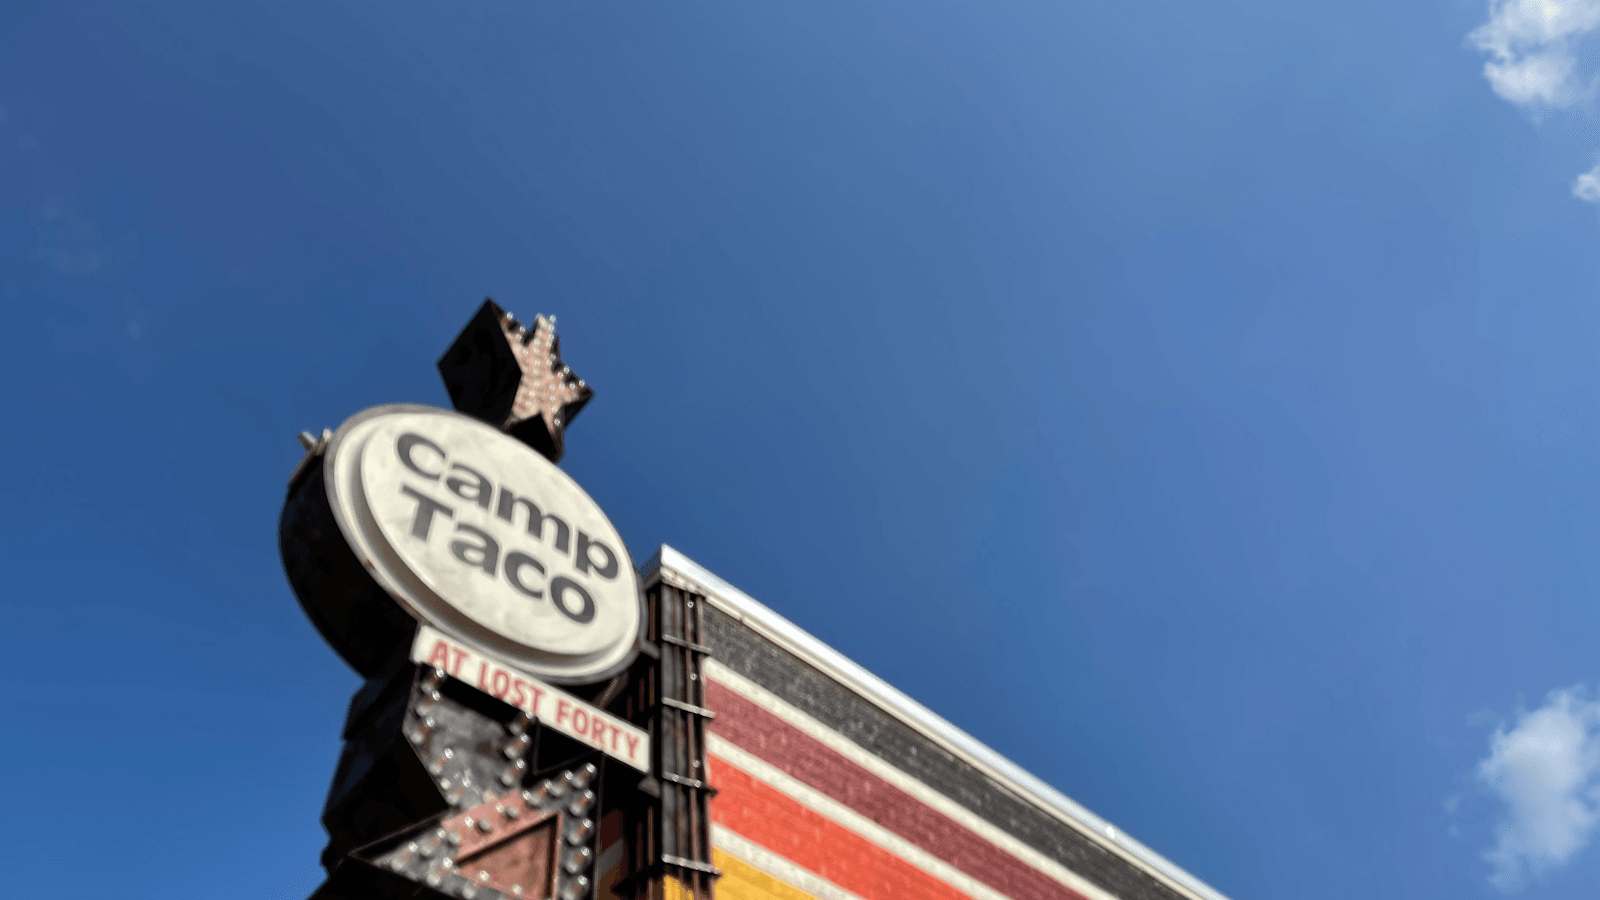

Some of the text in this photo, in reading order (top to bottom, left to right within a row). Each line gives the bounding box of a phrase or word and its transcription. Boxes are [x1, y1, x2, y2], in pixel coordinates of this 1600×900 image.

[397, 432, 619, 580] Camp
[401, 484, 596, 624] Taco
[427, 639, 641, 760] AT LOST FORTY
